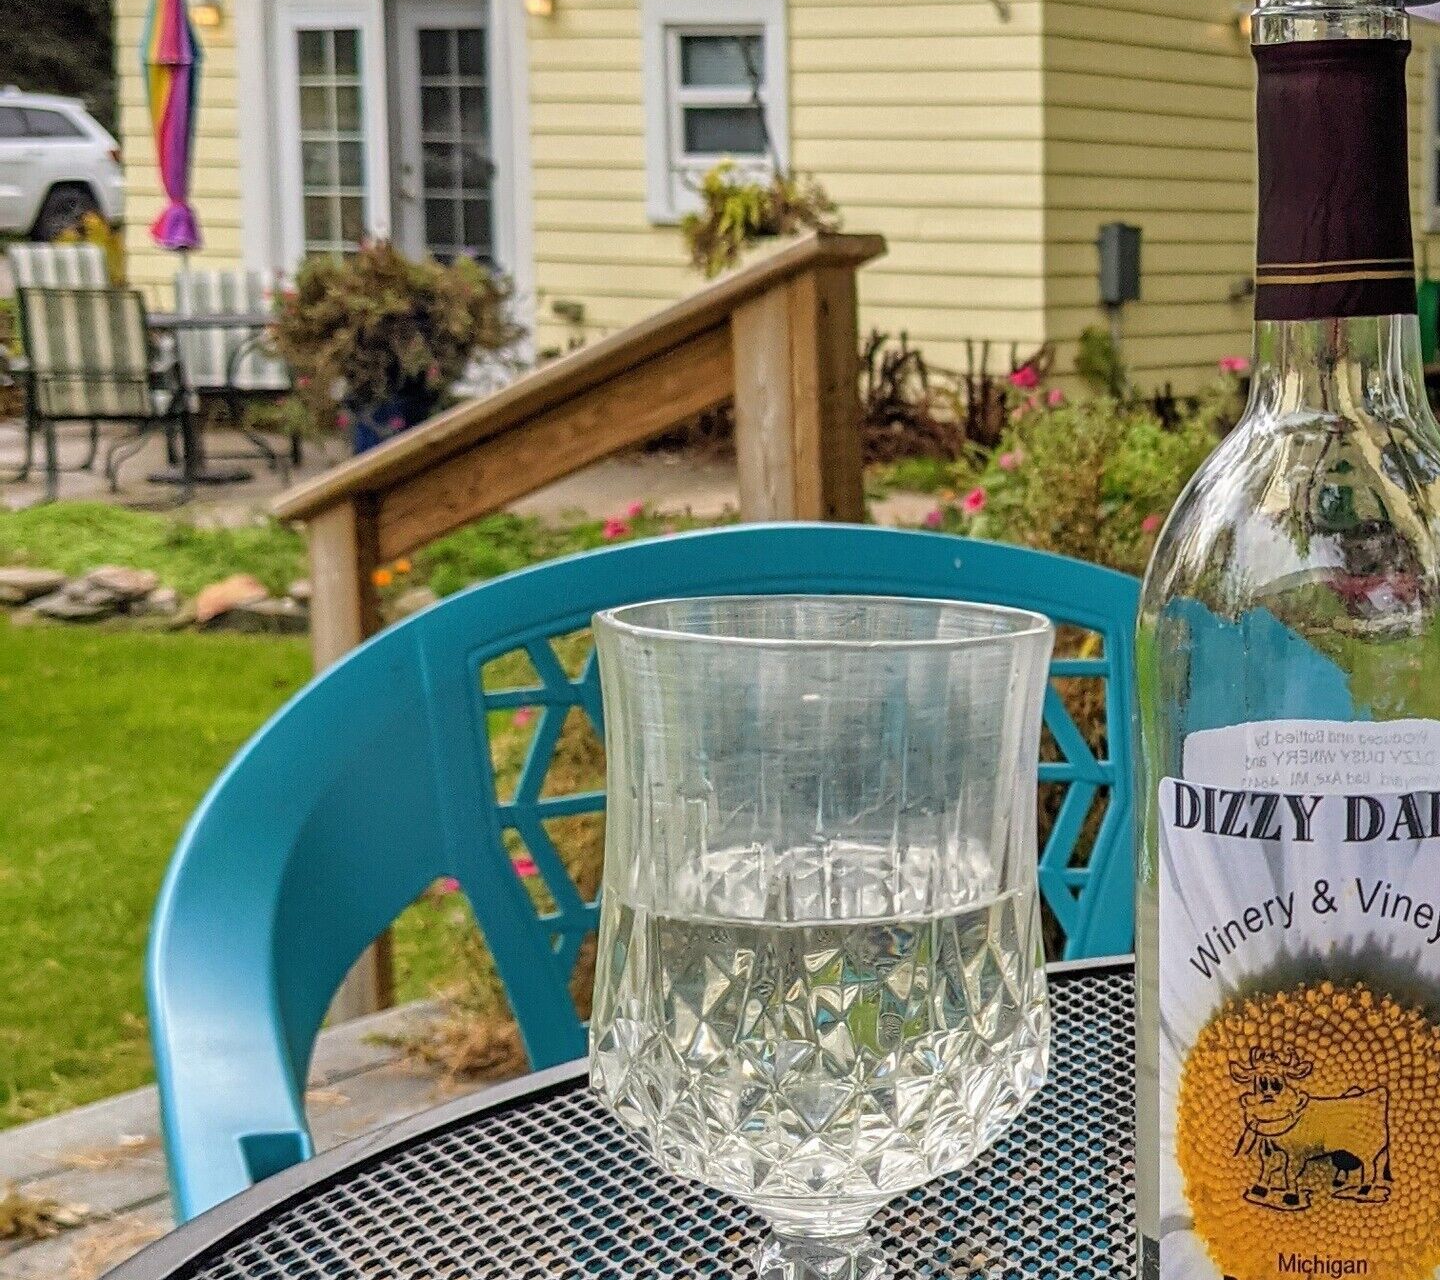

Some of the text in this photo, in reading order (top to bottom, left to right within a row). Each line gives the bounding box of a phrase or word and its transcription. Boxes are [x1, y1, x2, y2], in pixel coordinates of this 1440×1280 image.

[1173, 782, 1323, 842] DIZZY
[1189, 890, 1295, 980] Winery
[1312, 878, 1338, 914] &
[1278, 1252, 1368, 1278] Michigan
